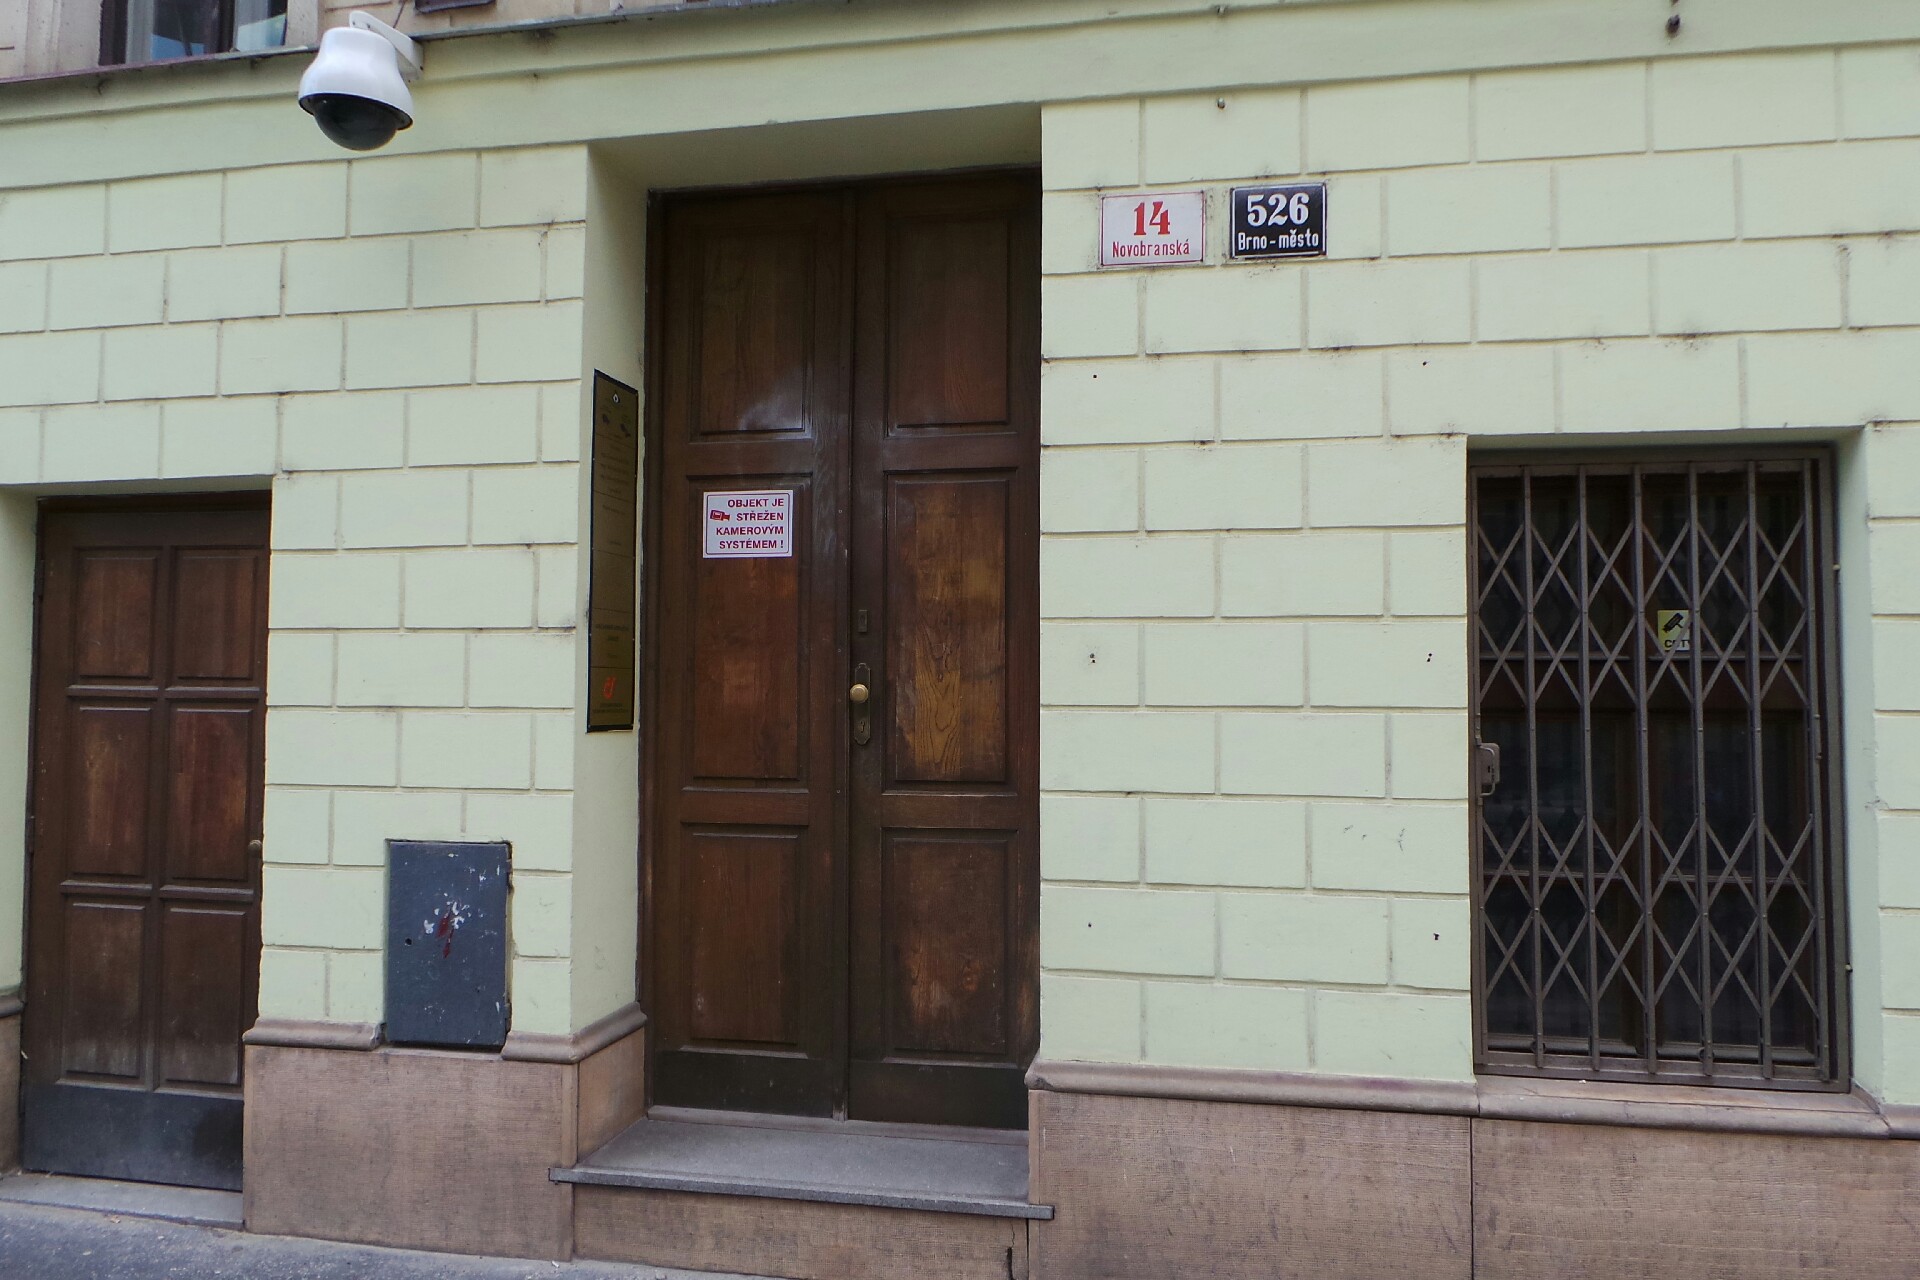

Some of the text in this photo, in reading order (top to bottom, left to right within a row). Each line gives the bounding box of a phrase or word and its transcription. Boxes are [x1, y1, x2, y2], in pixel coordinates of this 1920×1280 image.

[1247, 192, 1309, 227] 526
[1133, 201, 1170, 235] 14
[1112, 239, 1190, 258] Novobranská
[728, 498, 784, 508] OBJEKT JE
[736, 510, 784, 521] STŘEŽEN
[716, 524, 784, 536] KAMEROVÝM
[719, 538, 777, 549] SYSTÉMEM
